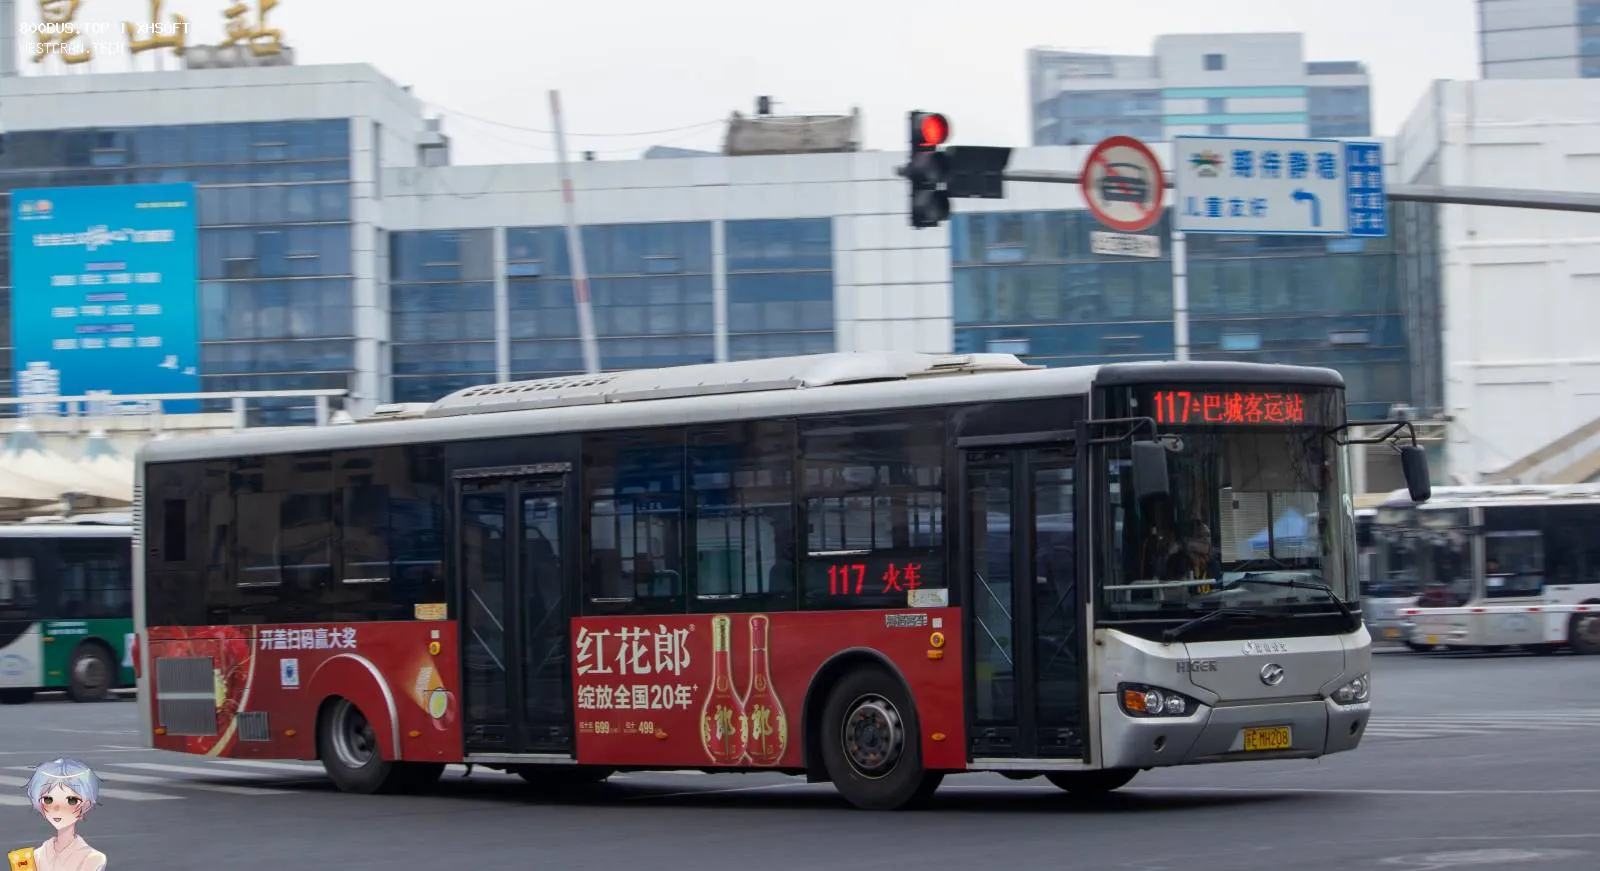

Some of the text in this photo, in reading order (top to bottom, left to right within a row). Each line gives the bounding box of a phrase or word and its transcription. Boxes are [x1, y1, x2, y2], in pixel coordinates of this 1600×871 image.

[1181, 197, 1269, 217] 儿童友好
[1154, 391, 1304, 423] 117 巴城客运站
[828, 563, 922, 595] 117 火车
[260, 627, 357, 650] 开盖扫码赢大奖
[576, 624, 691, 676] 红花郎
[1176, 660, 1218, 673] HIGER
